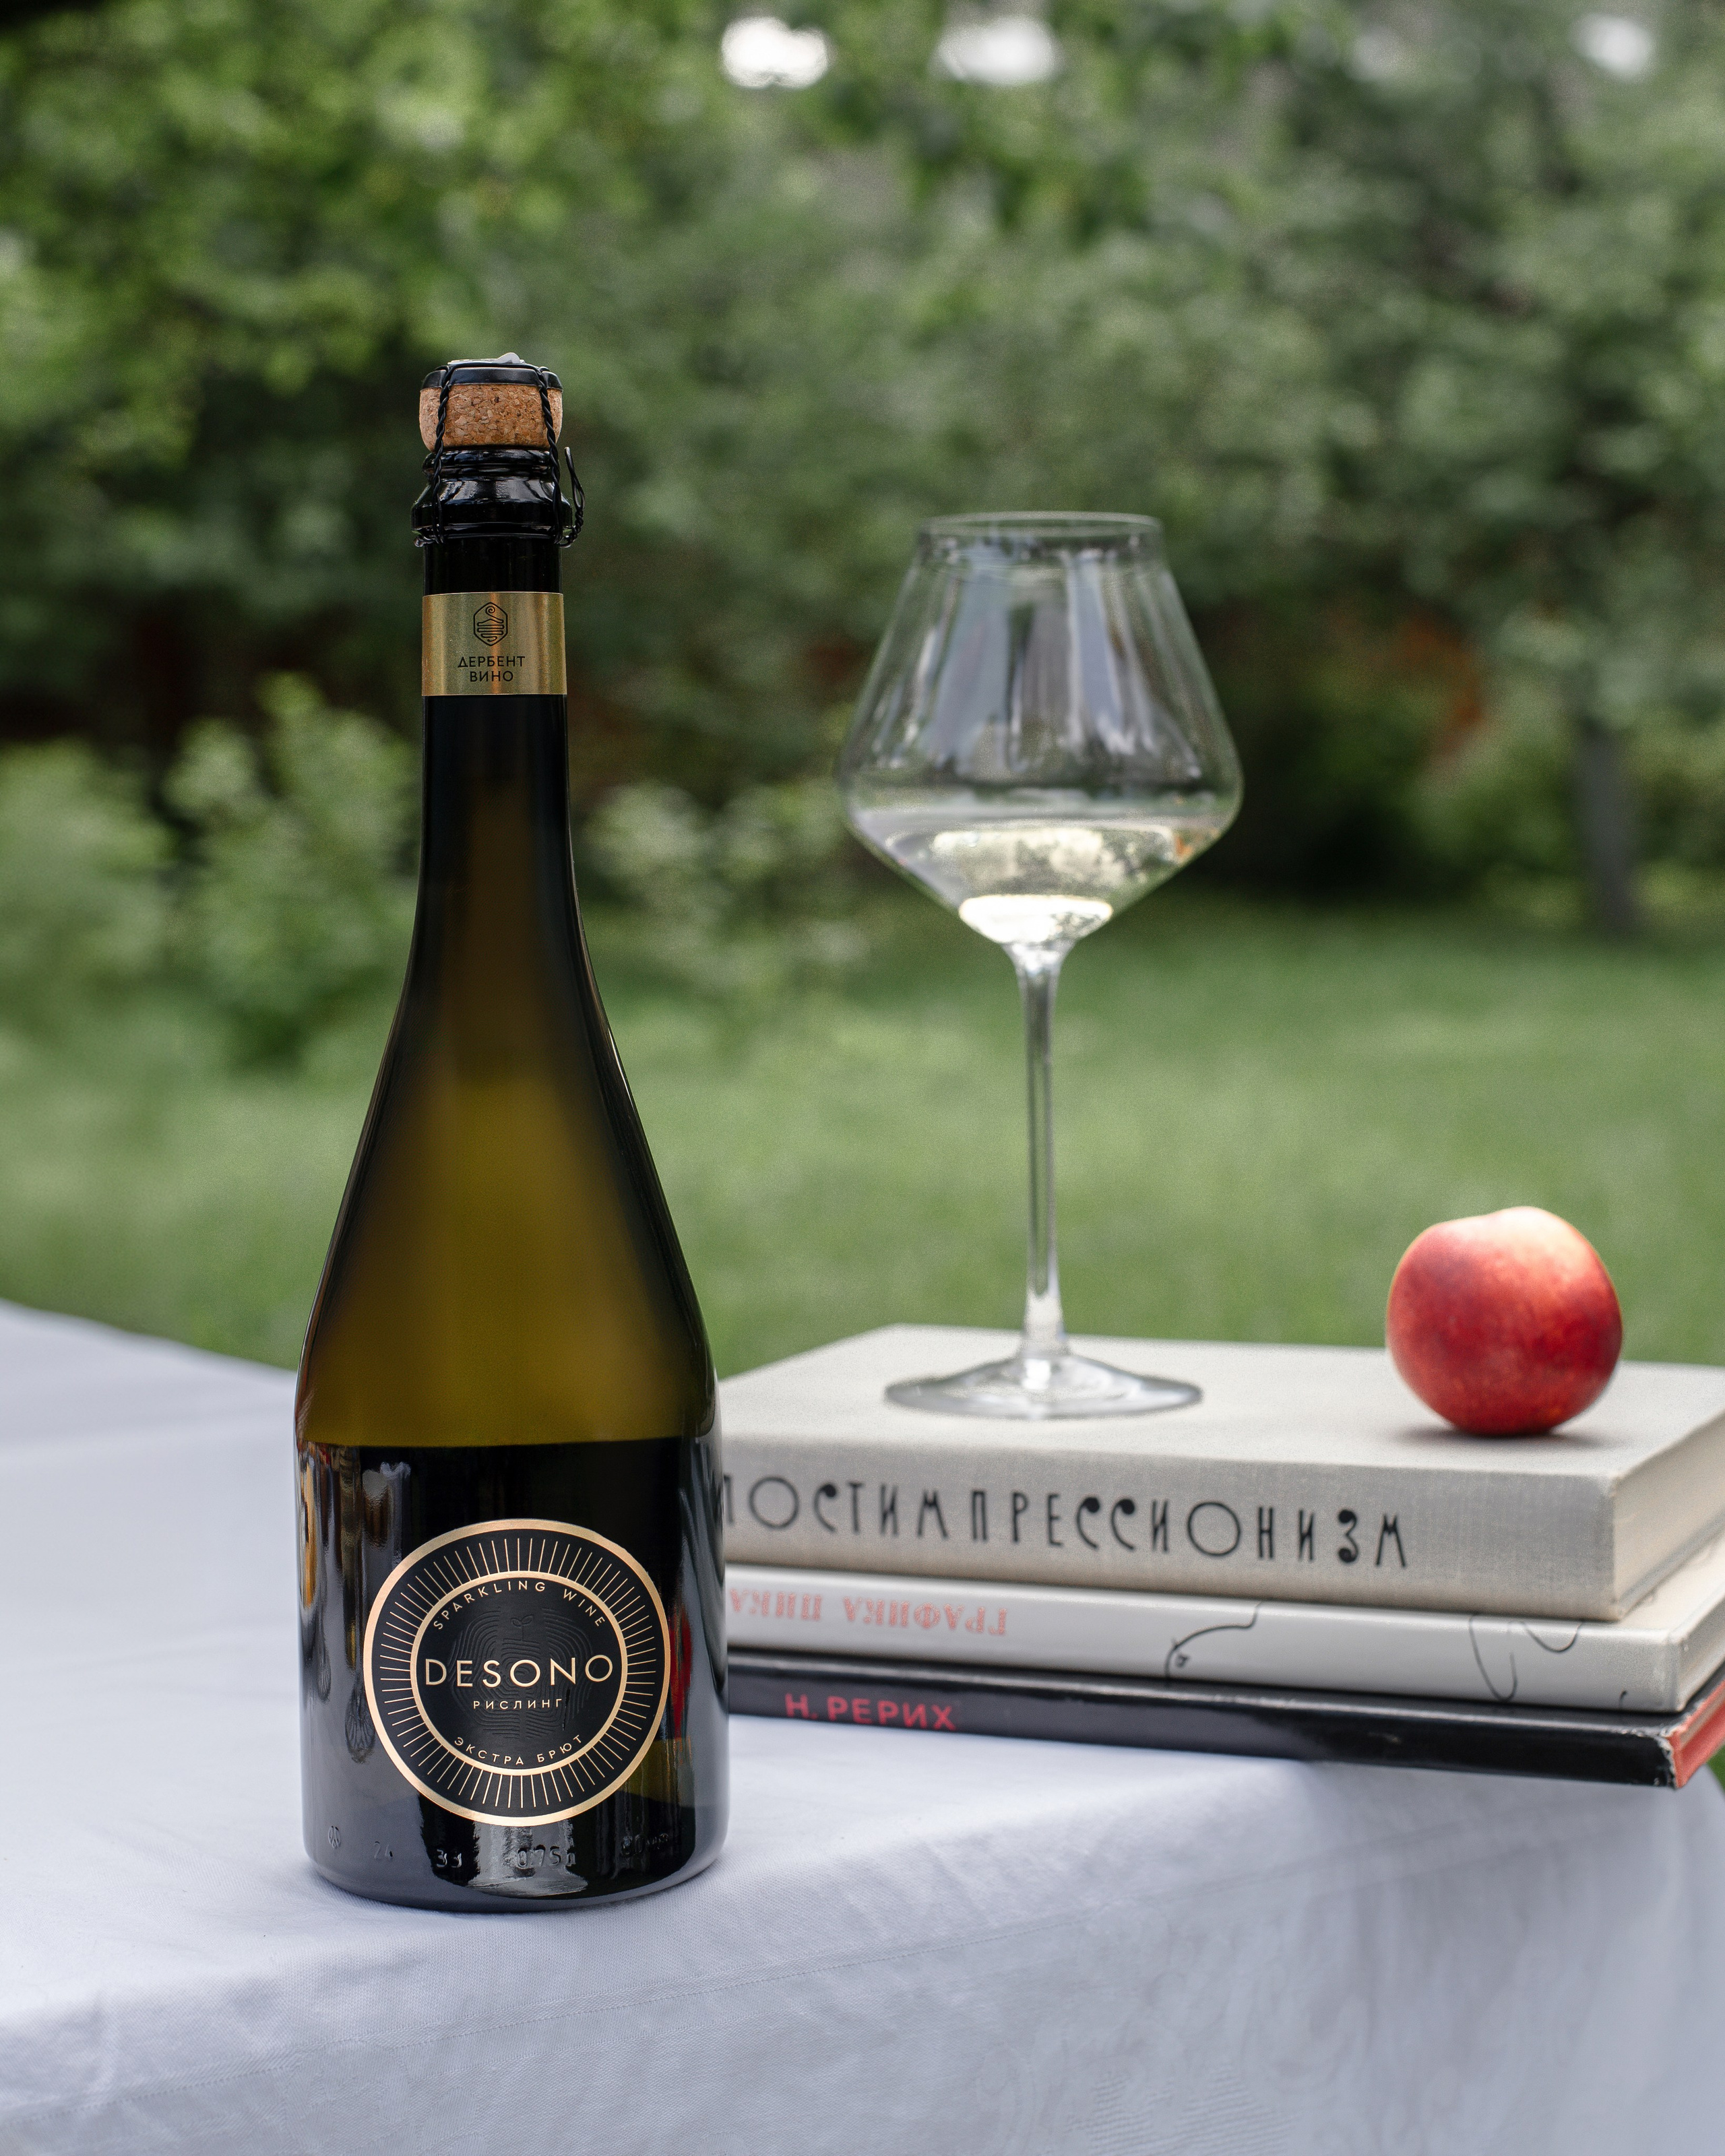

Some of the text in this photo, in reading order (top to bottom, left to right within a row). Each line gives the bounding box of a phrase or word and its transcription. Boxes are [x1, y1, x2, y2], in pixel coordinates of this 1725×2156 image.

[458, 656, 525, 668] ДЕРБЕНТ
[470, 670, 514, 682] ВИНО
[433, 1580, 606, 1630] SPARKLING WINE
[842, 1596, 1008, 1635] ГРАФИКА
[425, 1654, 613, 1688] DESONO
[473, 1698, 563, 1710] РИСЛИНГ
[785, 1692, 957, 1731] Н. РЕРИХ
[453, 1734, 584, 1766] ЭКСТРА БРЮТ
